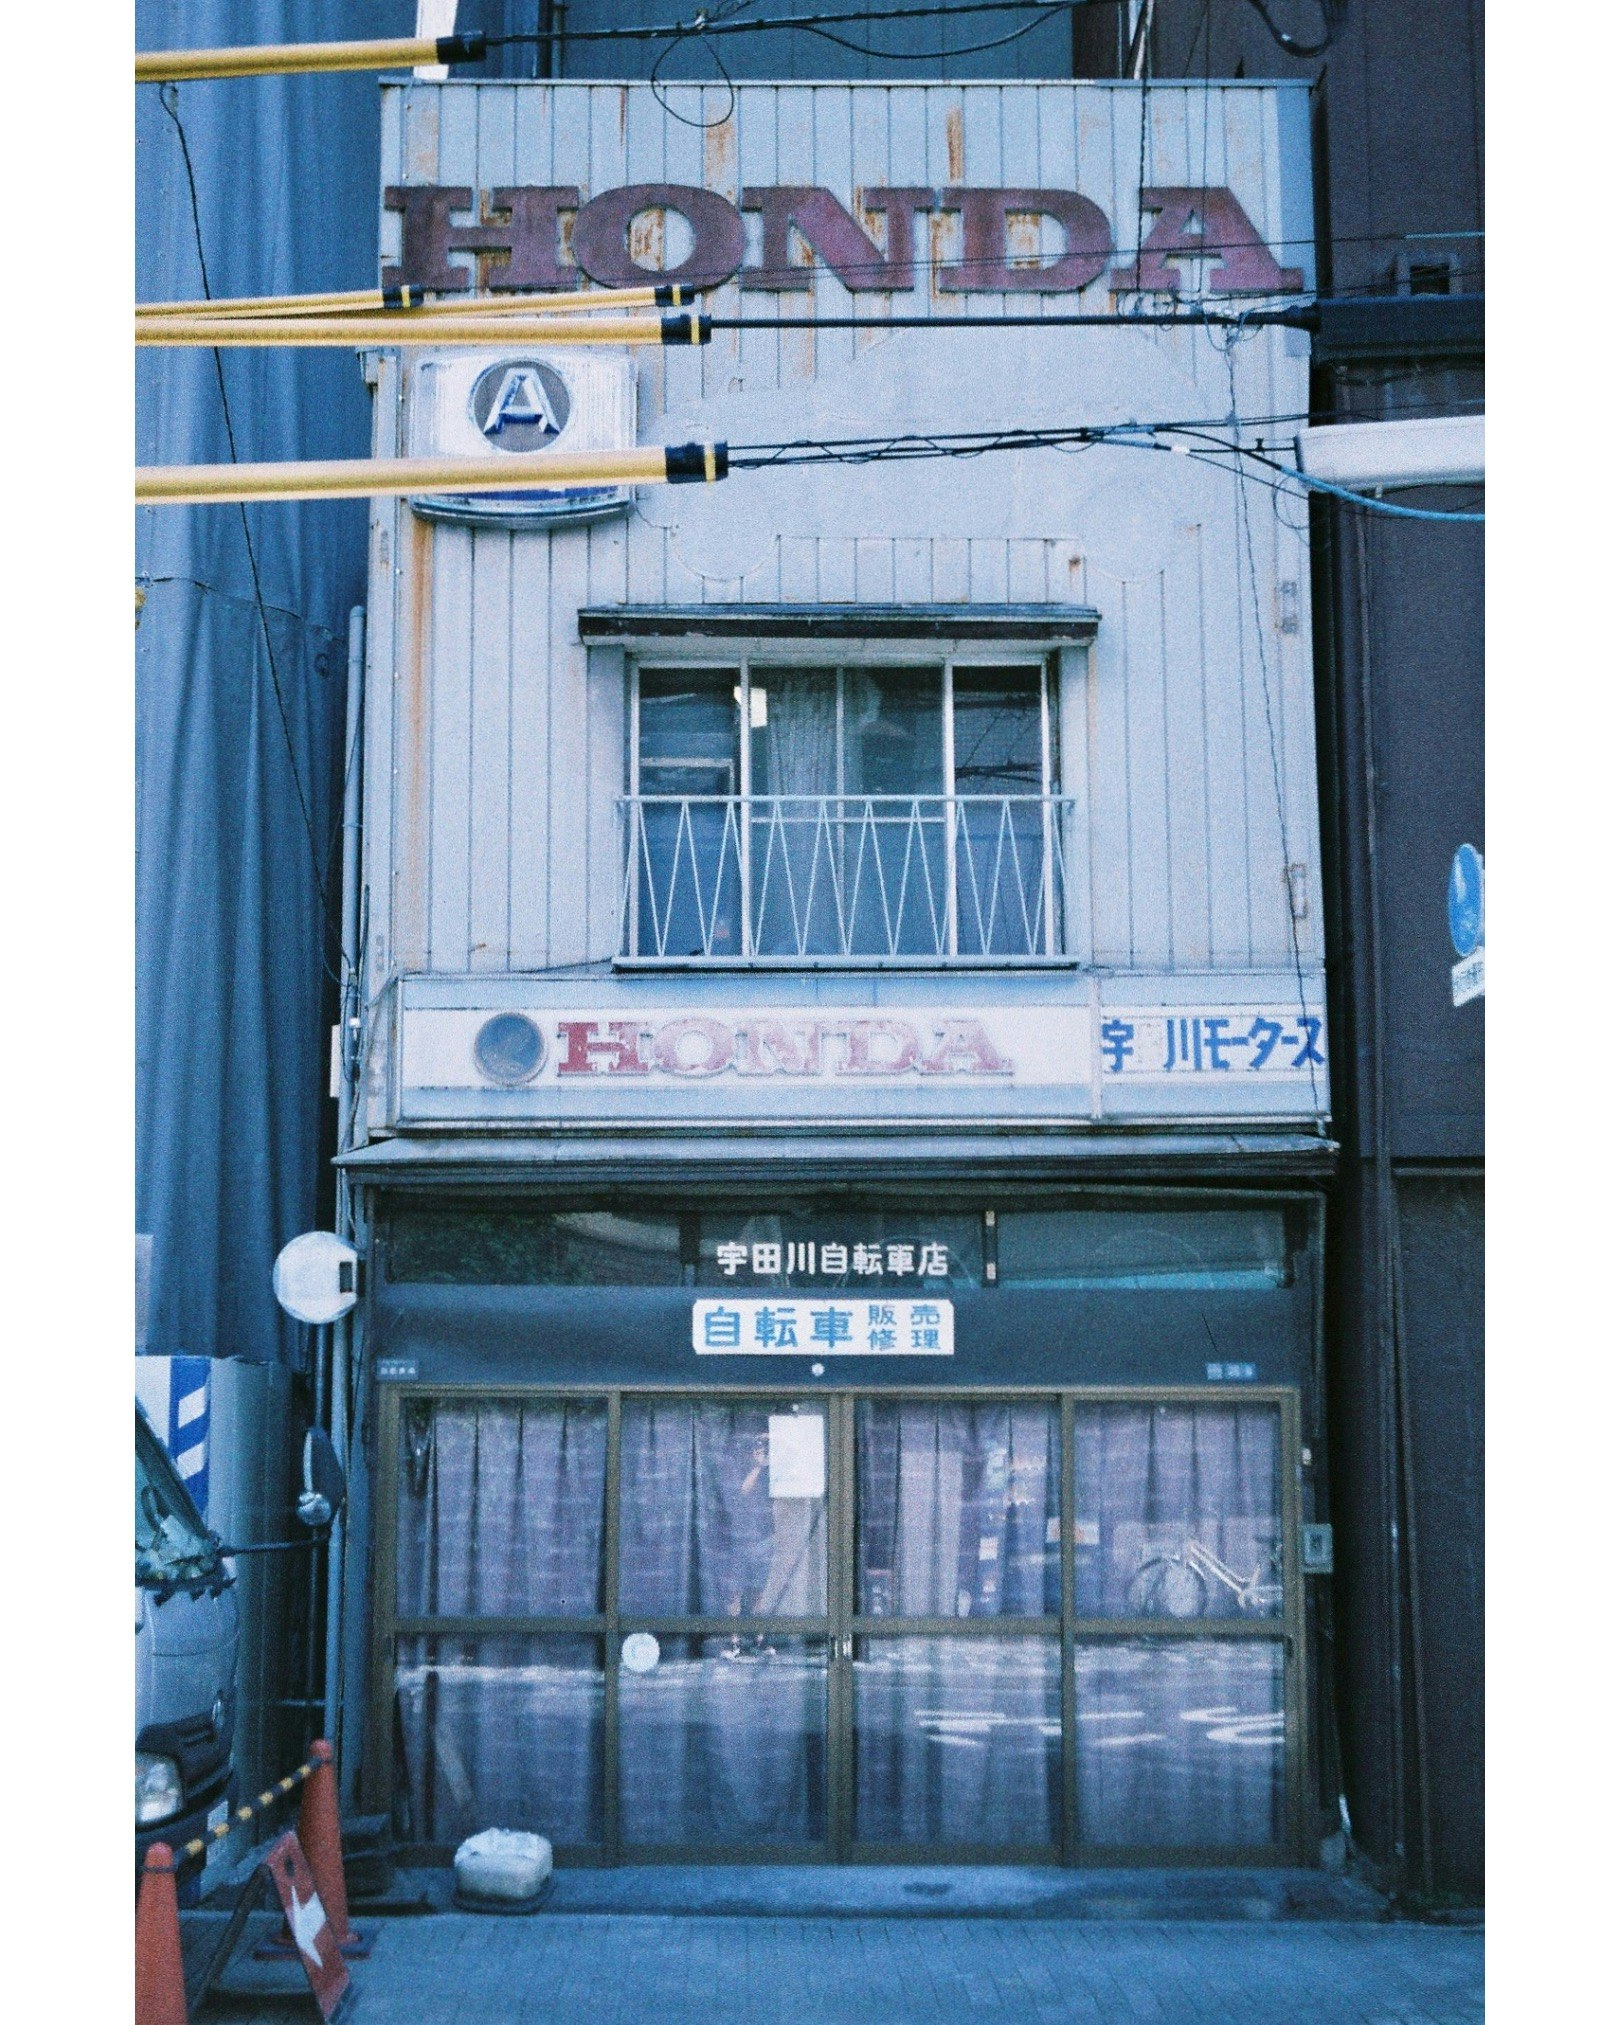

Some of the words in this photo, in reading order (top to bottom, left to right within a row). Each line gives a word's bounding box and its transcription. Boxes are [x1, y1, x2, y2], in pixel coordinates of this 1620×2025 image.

[382, 183, 1303, 293] HONDA
[483, 367, 560, 434] A
[556, 1015, 1014, 1077] HONDA
[717, 1242, 948, 1276] 宇田川自転車店
[705, 1306, 853, 1347] 自転車
[868, 1304, 940, 1326] 販売
[867, 1328, 941, 1350] 修理
